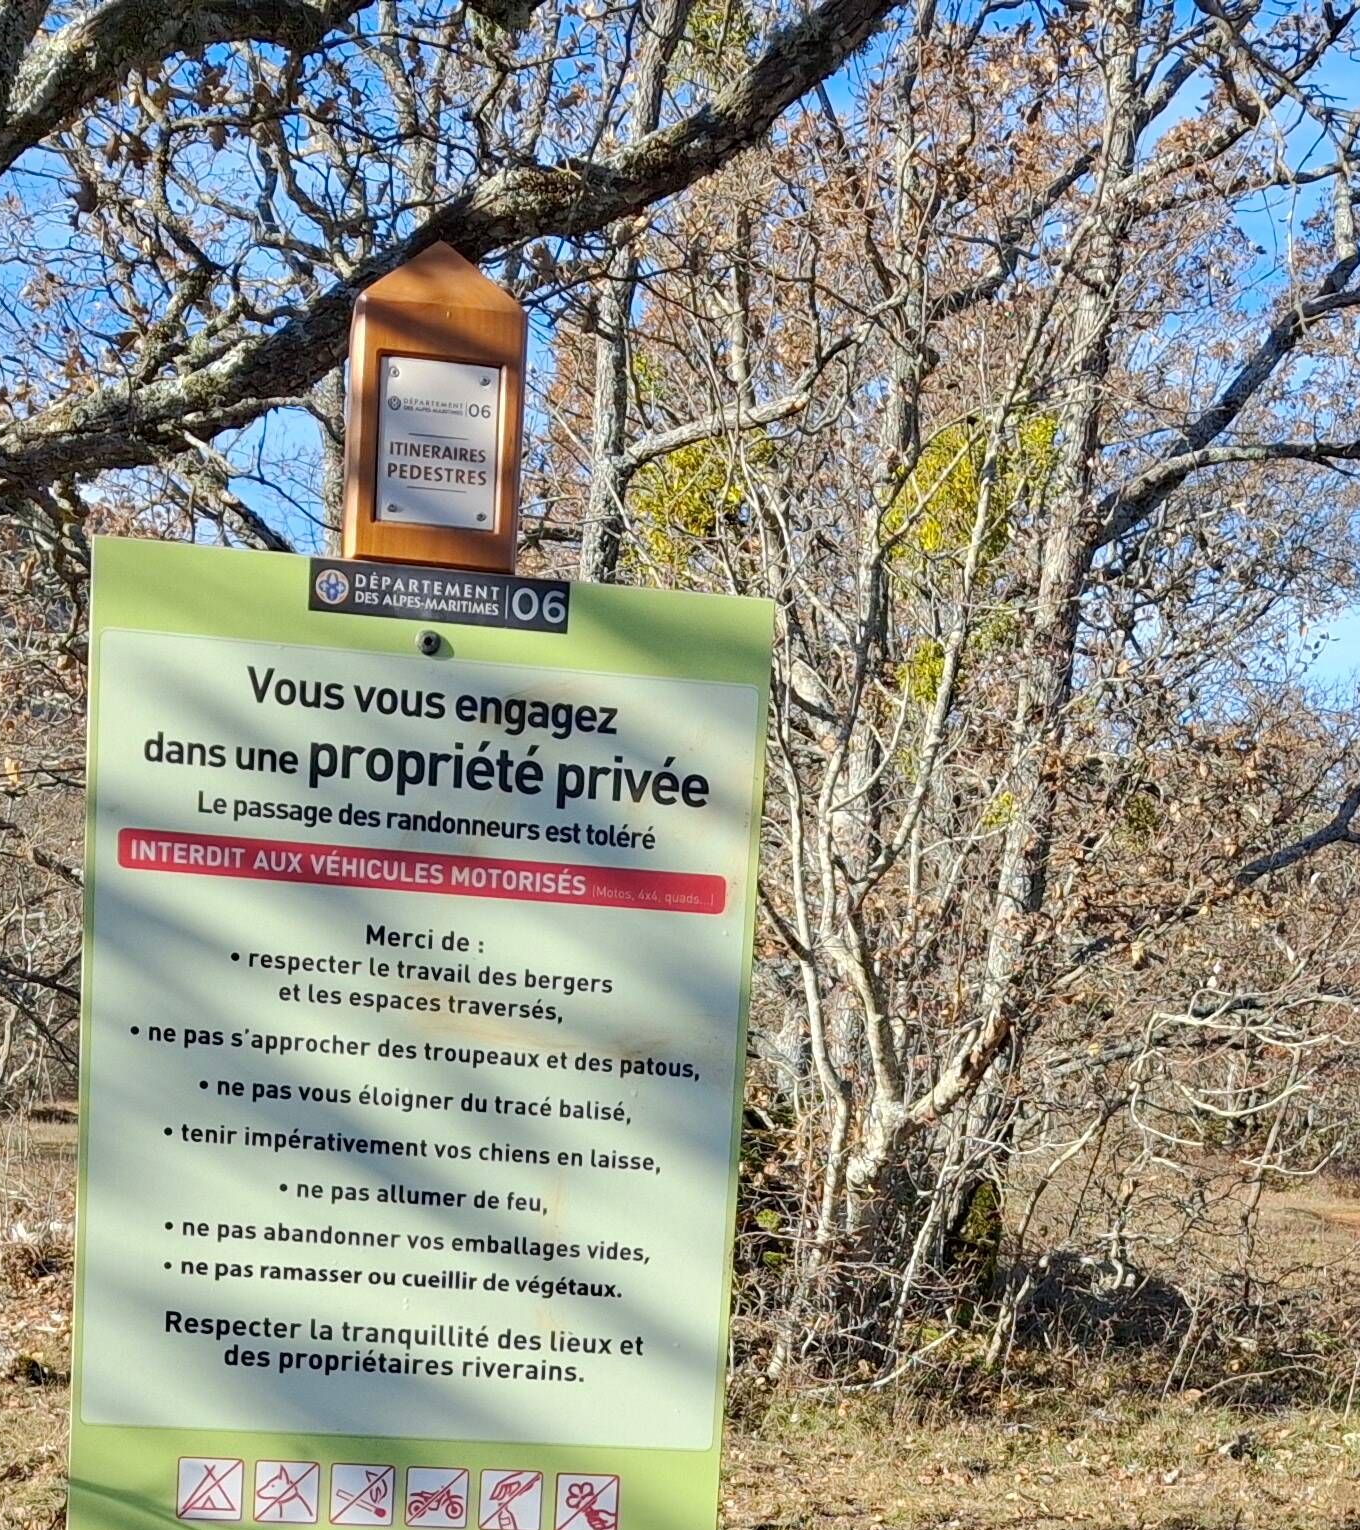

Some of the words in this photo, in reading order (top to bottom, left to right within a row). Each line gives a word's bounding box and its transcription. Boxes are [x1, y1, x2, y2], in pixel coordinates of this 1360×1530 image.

[468, 403, 492, 419] 06
[389, 441, 486, 463] ITINERAIRES
[387, 462, 487, 485] PEDESTRES
[355, 571, 499, 599] DÉPARTEMENT
[512, 588, 566, 624] 06
[355, 591, 378, 604] DES
[382, 594, 499, 616] ALPES-MARITIMES
[247, 666, 344, 710] Vous
[354, 685, 445, 719] vous
[456, 695, 618, 739] engagez
[144, 731, 226, 767] dans
[236, 747, 298, 774] une
[309, 741, 543, 795] propriété
[557, 756, 709, 809] privée
[198, 791, 227, 814] Le
[234, 800, 332, 827] passage
[339, 803, 380, 827] des
[387, 811, 540, 840] randonneurs
[546, 823, 581, 844] est
[586, 824, 655, 849] toléré
[132, 841, 244, 867] INTERDIT
[254, 851, 301, 872] AUX
[311, 851, 442, 884] VÉHICULES
[452, 867, 585, 895] MOTORISÉS
[366, 924, 433, 949] Merci
[442, 931, 469, 952] de
[249, 953, 362, 975] respecter
[370, 957, 389, 977] le
[397, 961, 470, 983] travail
[479, 966, 516, 986] des
[525, 969, 612, 995] bergers
[279, 984, 300, 1002] et
[309, 984, 341, 1005] les
[349, 992, 440, 1013] espaces
[448, 996, 562, 1024] traversés,
[149, 1026, 176, 1042] ne
[184, 1029, 224, 1048] pas
[231, 1029, 371, 1056] s'approcher
[378, 1038, 417, 1059] des
[424, 1043, 539, 1068] troupeaux
[547, 1052, 567, 1069] et
[575, 1052, 612, 1072] des
[620, 1057, 699, 1082] patous,
[218, 1081, 244, 1096] ne
[252, 1083, 291, 1102] pas
[298, 1086, 351, 1103] vous
[359, 1085, 454, 1112] éloigner
[461, 1093, 487, 1113] du
[494, 1096, 551, 1116] tracé
[560, 1099, 631, 1125] balisé,
[181, 1124, 237, 1144] tenir
[245, 1127, 427, 1157] impérativement
[434, 1144, 471, 1159] vos
[479, 1143, 550, 1164] chiens
[557, 1152, 582, 1167] en
[591, 1149, 660, 1175] laisse,
[297, 1184, 323, 1198] ne
[331, 1186, 369, 1204] pas
[377, 1184, 467, 1207] allumer
[474, 1190, 499, 1209] de
[507, 1192, 547, 1216] feu,
[183, 1222, 209, 1237] ne
[218, 1224, 256, 1242] pas
[264, 1223, 401, 1248] abandonner
[407, 1235, 444, 1250] vos
[452, 1235, 580, 1261] emballages
[587, 1241, 650, 1264] vides,
[181, 1261, 208, 1275] ne
[215, 1263, 253, 1281] pas
[260, 1266, 362, 1284] ramasser
[368, 1272, 395, 1286] ou
[402, 1271, 477, 1290] cueillir
[483, 1273, 509, 1292] de
[516, 1275, 622, 1299] végétaux.
[166, 1310, 302, 1340] Respecter
[311, 1319, 332, 1340] la
[342, 1322, 489, 1350] tranquillité
[498, 1329, 541, 1350] des
[551, 1331, 612, 1354] lieux
[620, 1336, 644, 1356] et
[224, 1344, 270, 1367] des
[279, 1350, 453, 1376] propriétaires
[463, 1357, 584, 1382] riverains.
